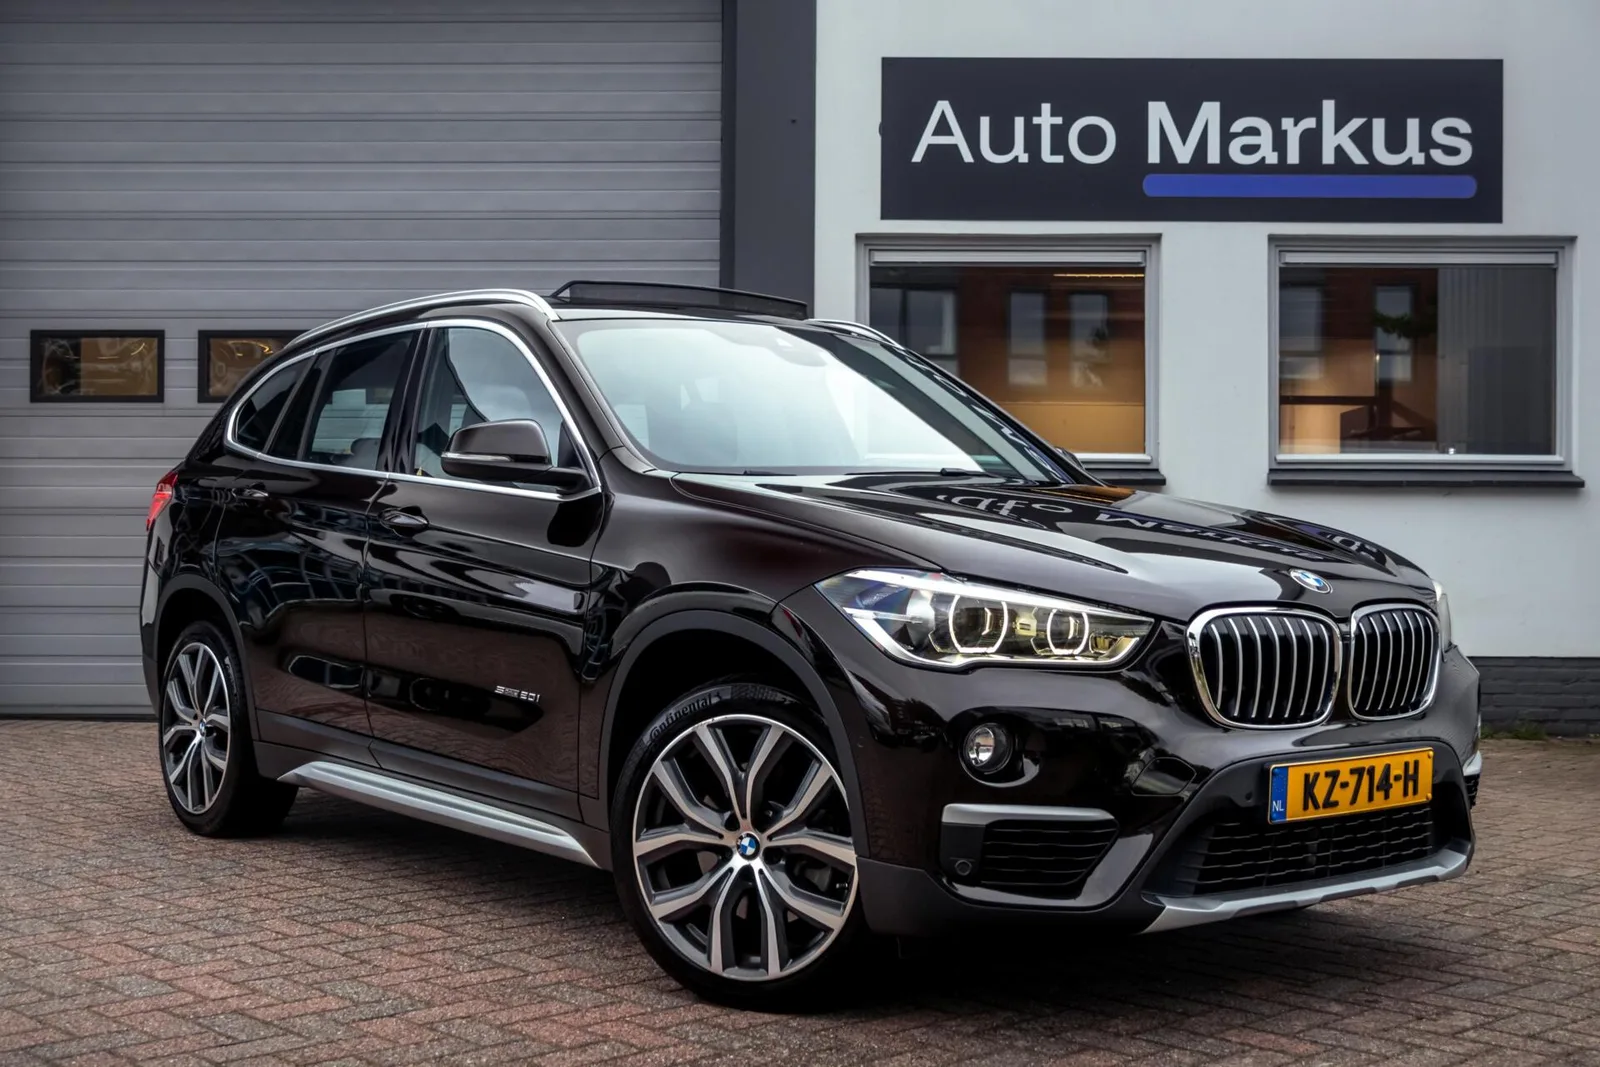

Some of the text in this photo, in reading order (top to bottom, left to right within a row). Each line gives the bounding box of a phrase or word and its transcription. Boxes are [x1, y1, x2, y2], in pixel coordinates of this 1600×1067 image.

[911, 99, 1474, 166] Auto Markus
[648, 691, 714, 742] Continental
[1272, 800, 1285, 812] NL
[1302, 760, 1420, 812] KZ-714-H
